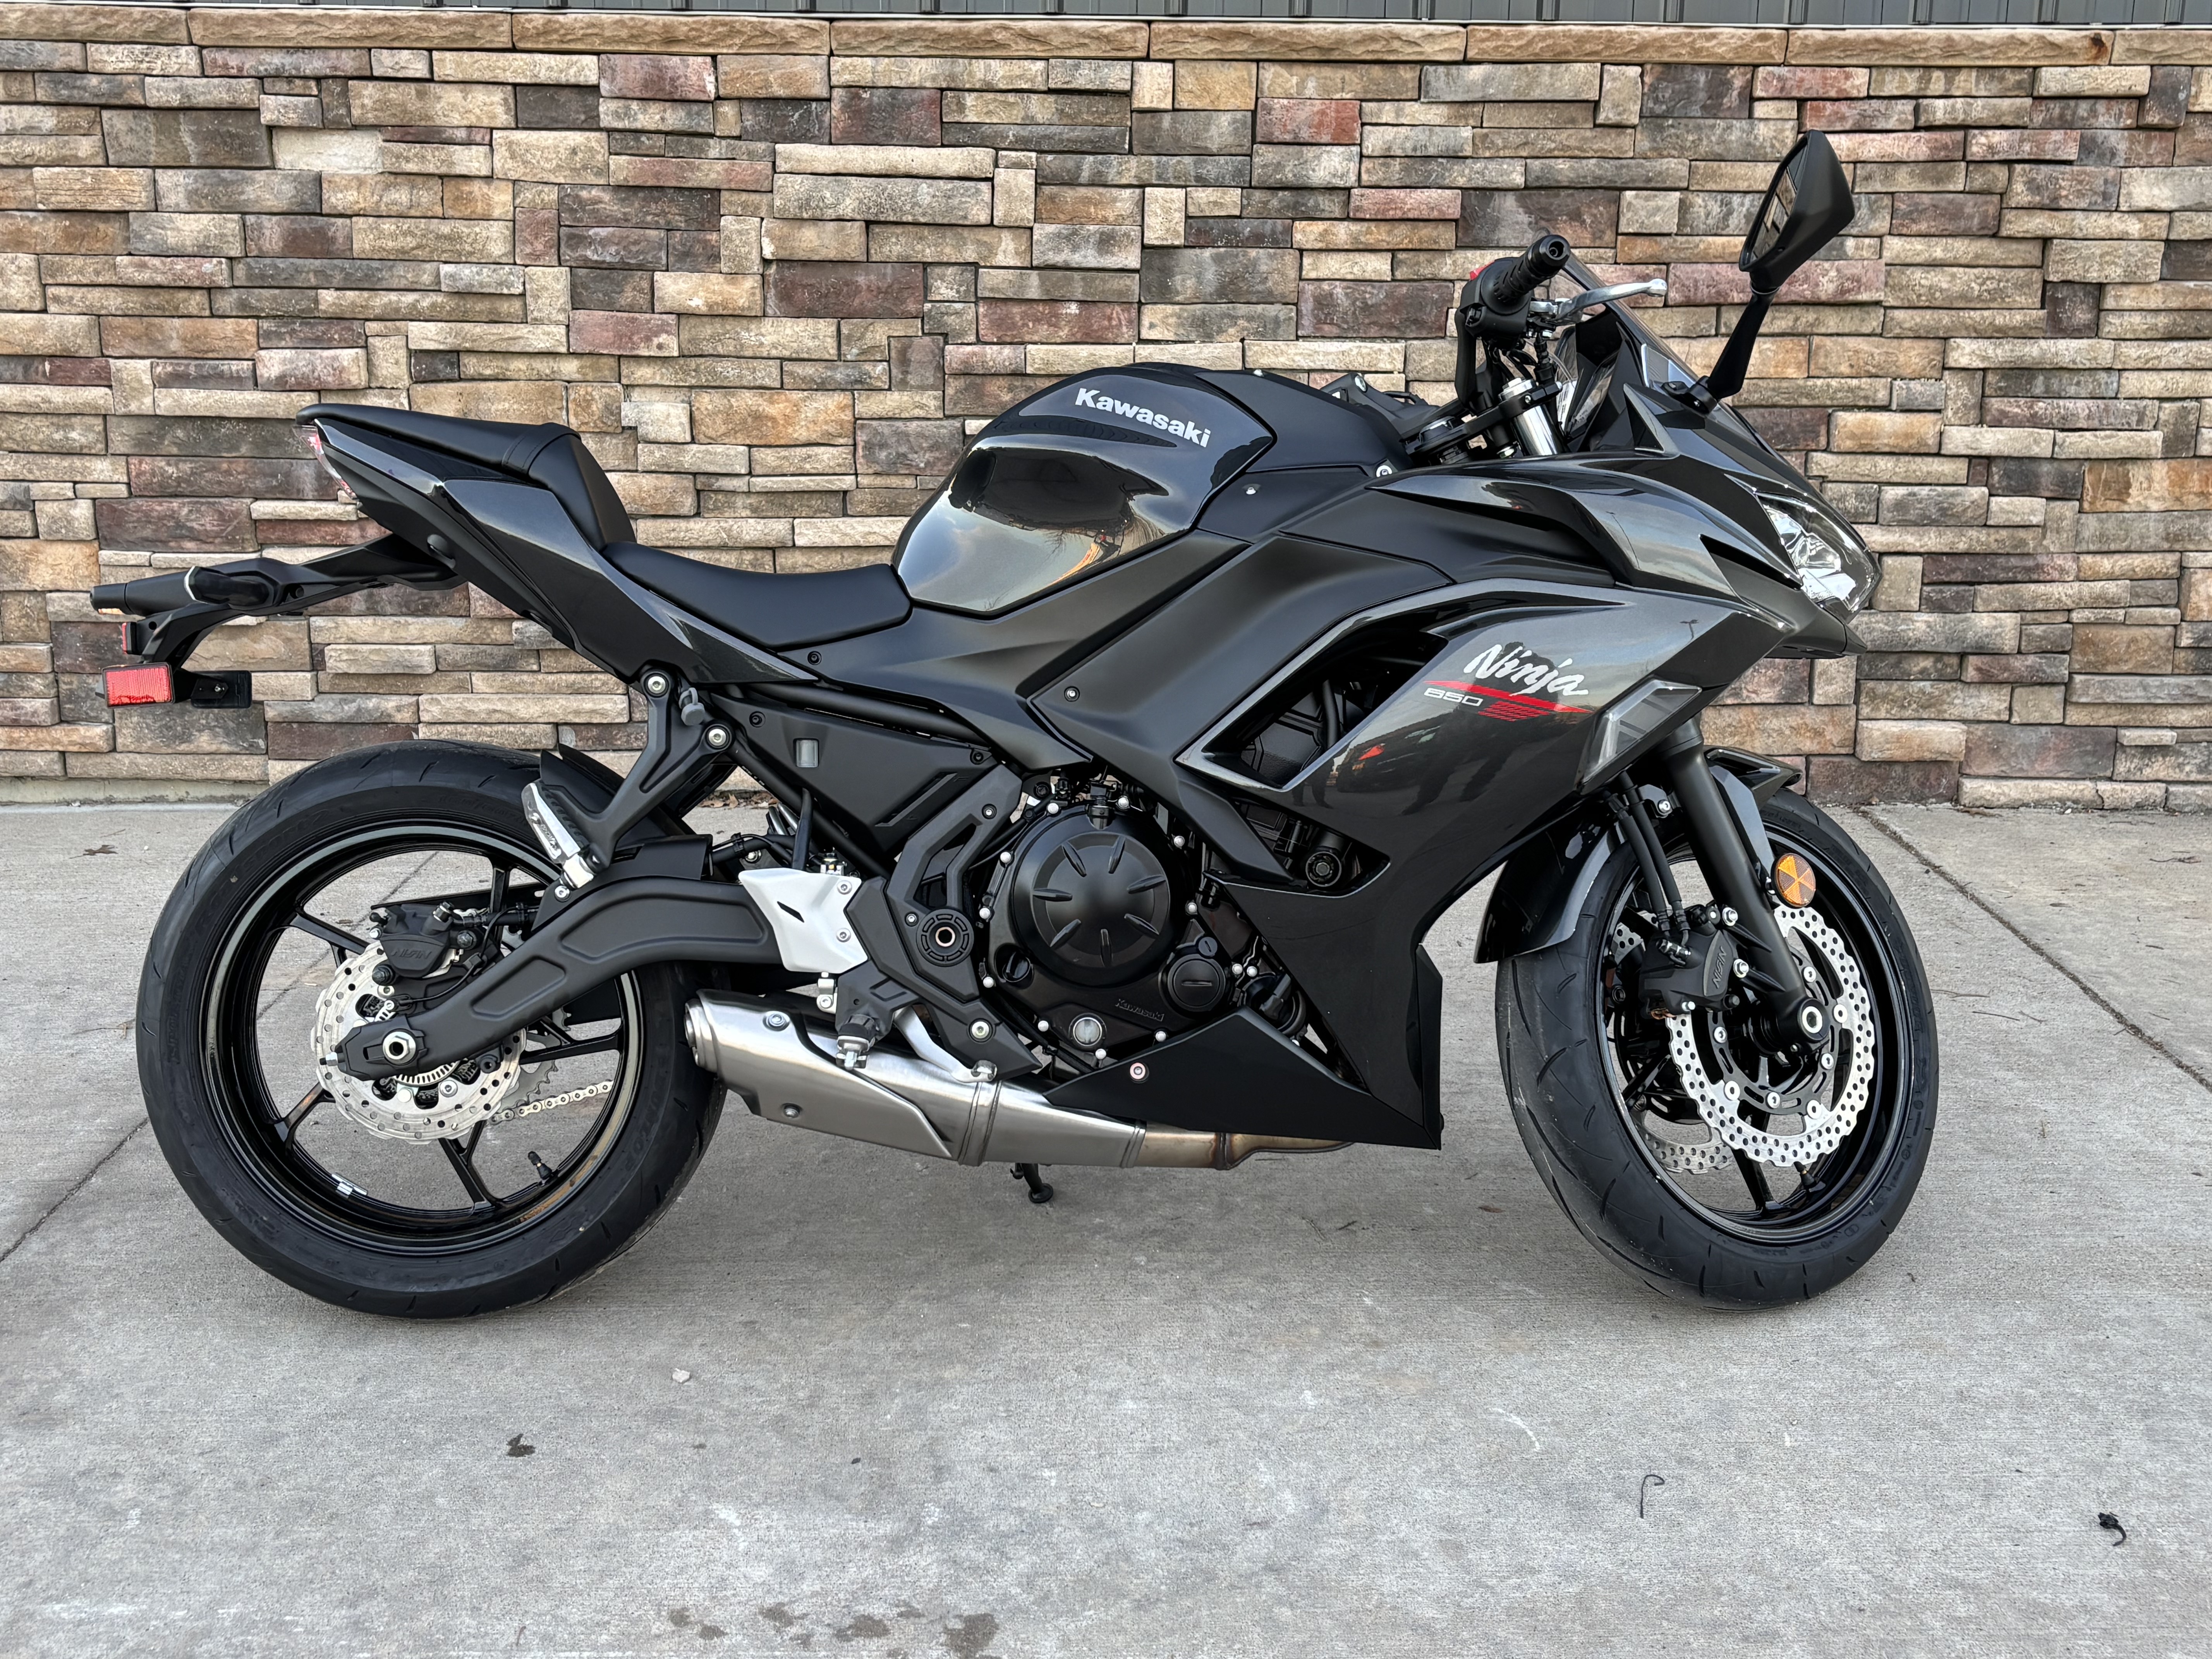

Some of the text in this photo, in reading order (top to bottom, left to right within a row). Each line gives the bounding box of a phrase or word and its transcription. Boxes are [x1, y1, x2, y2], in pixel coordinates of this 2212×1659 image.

[1075, 388, 1211, 448] Kawasaki
[1463, 644, 1589, 696] Ninja
[1424, 687, 1483, 707] 650
[1115, 998, 1165, 1022] Kawasaki
